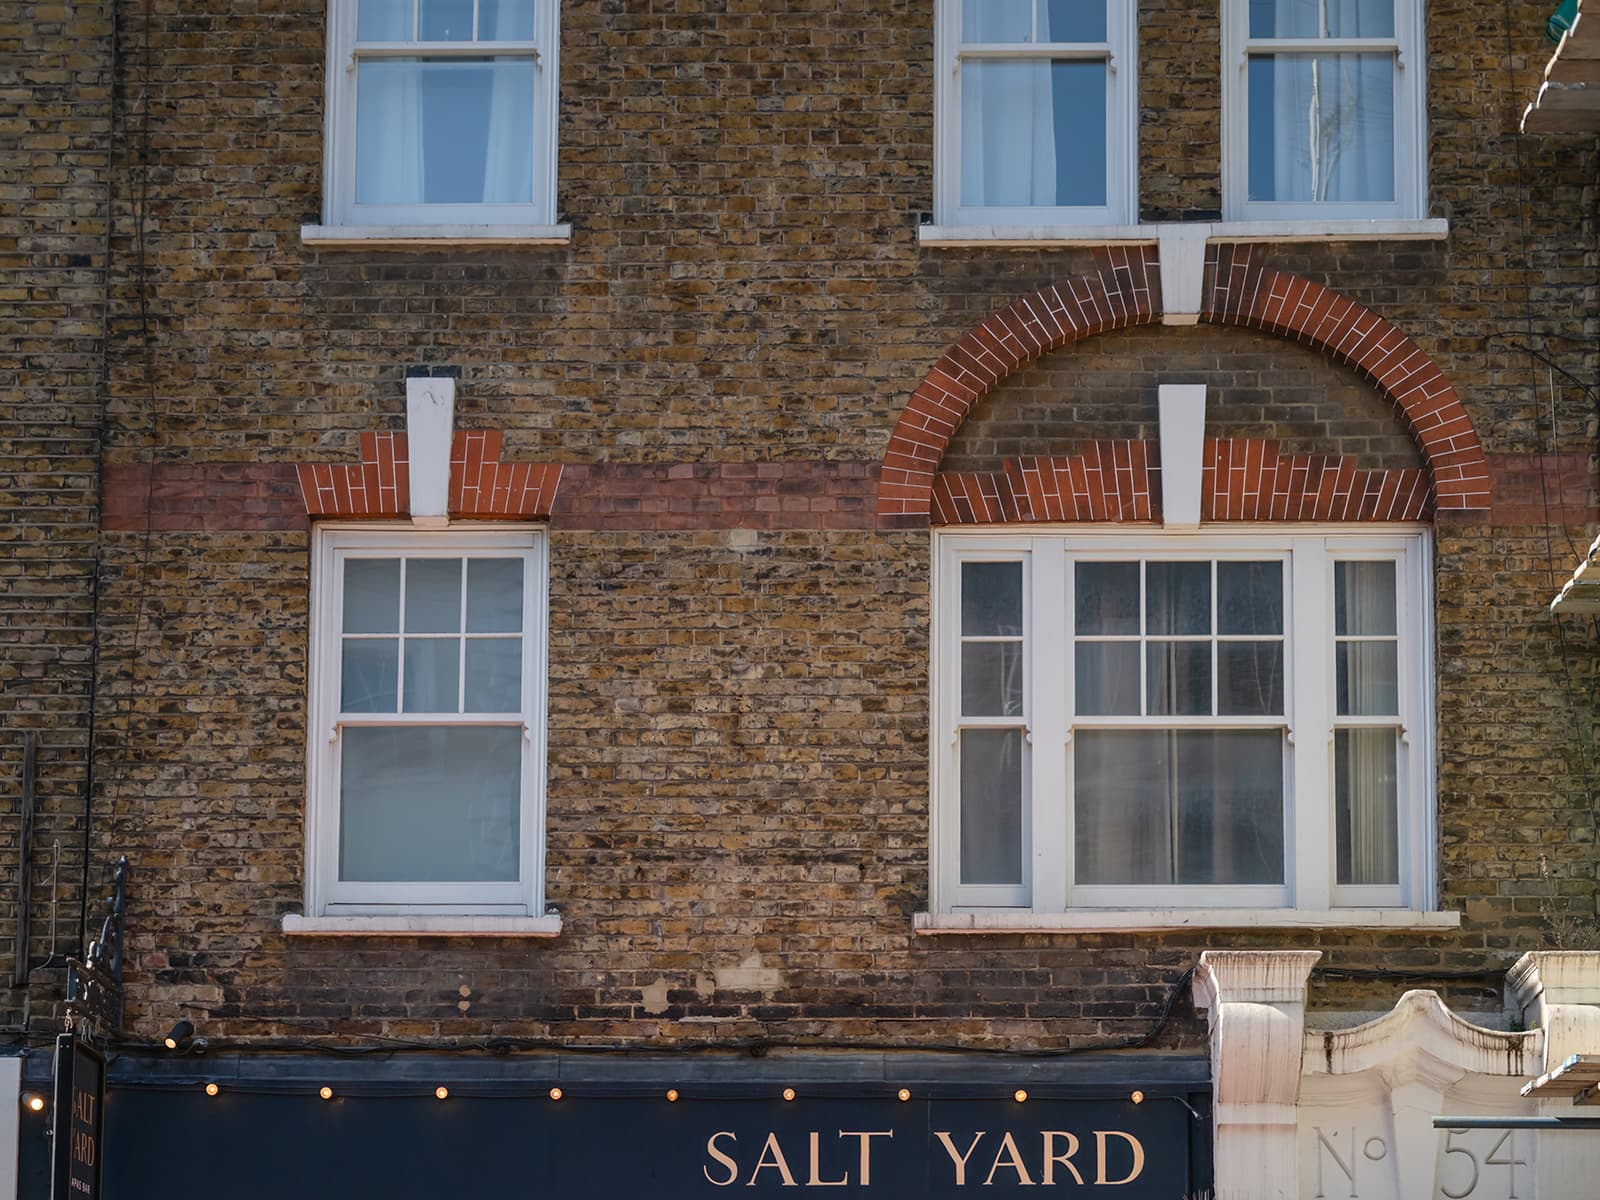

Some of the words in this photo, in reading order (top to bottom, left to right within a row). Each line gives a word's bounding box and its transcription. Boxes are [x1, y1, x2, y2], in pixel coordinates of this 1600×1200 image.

[73, 1089, 95, 1125] ALT
[73, 1128, 95, 1166] ARD
[703, 1129, 893, 1186] SALT
[934, 1131, 1145, 1185] YARD
[1441, 1127, 1527, 1199] 54
